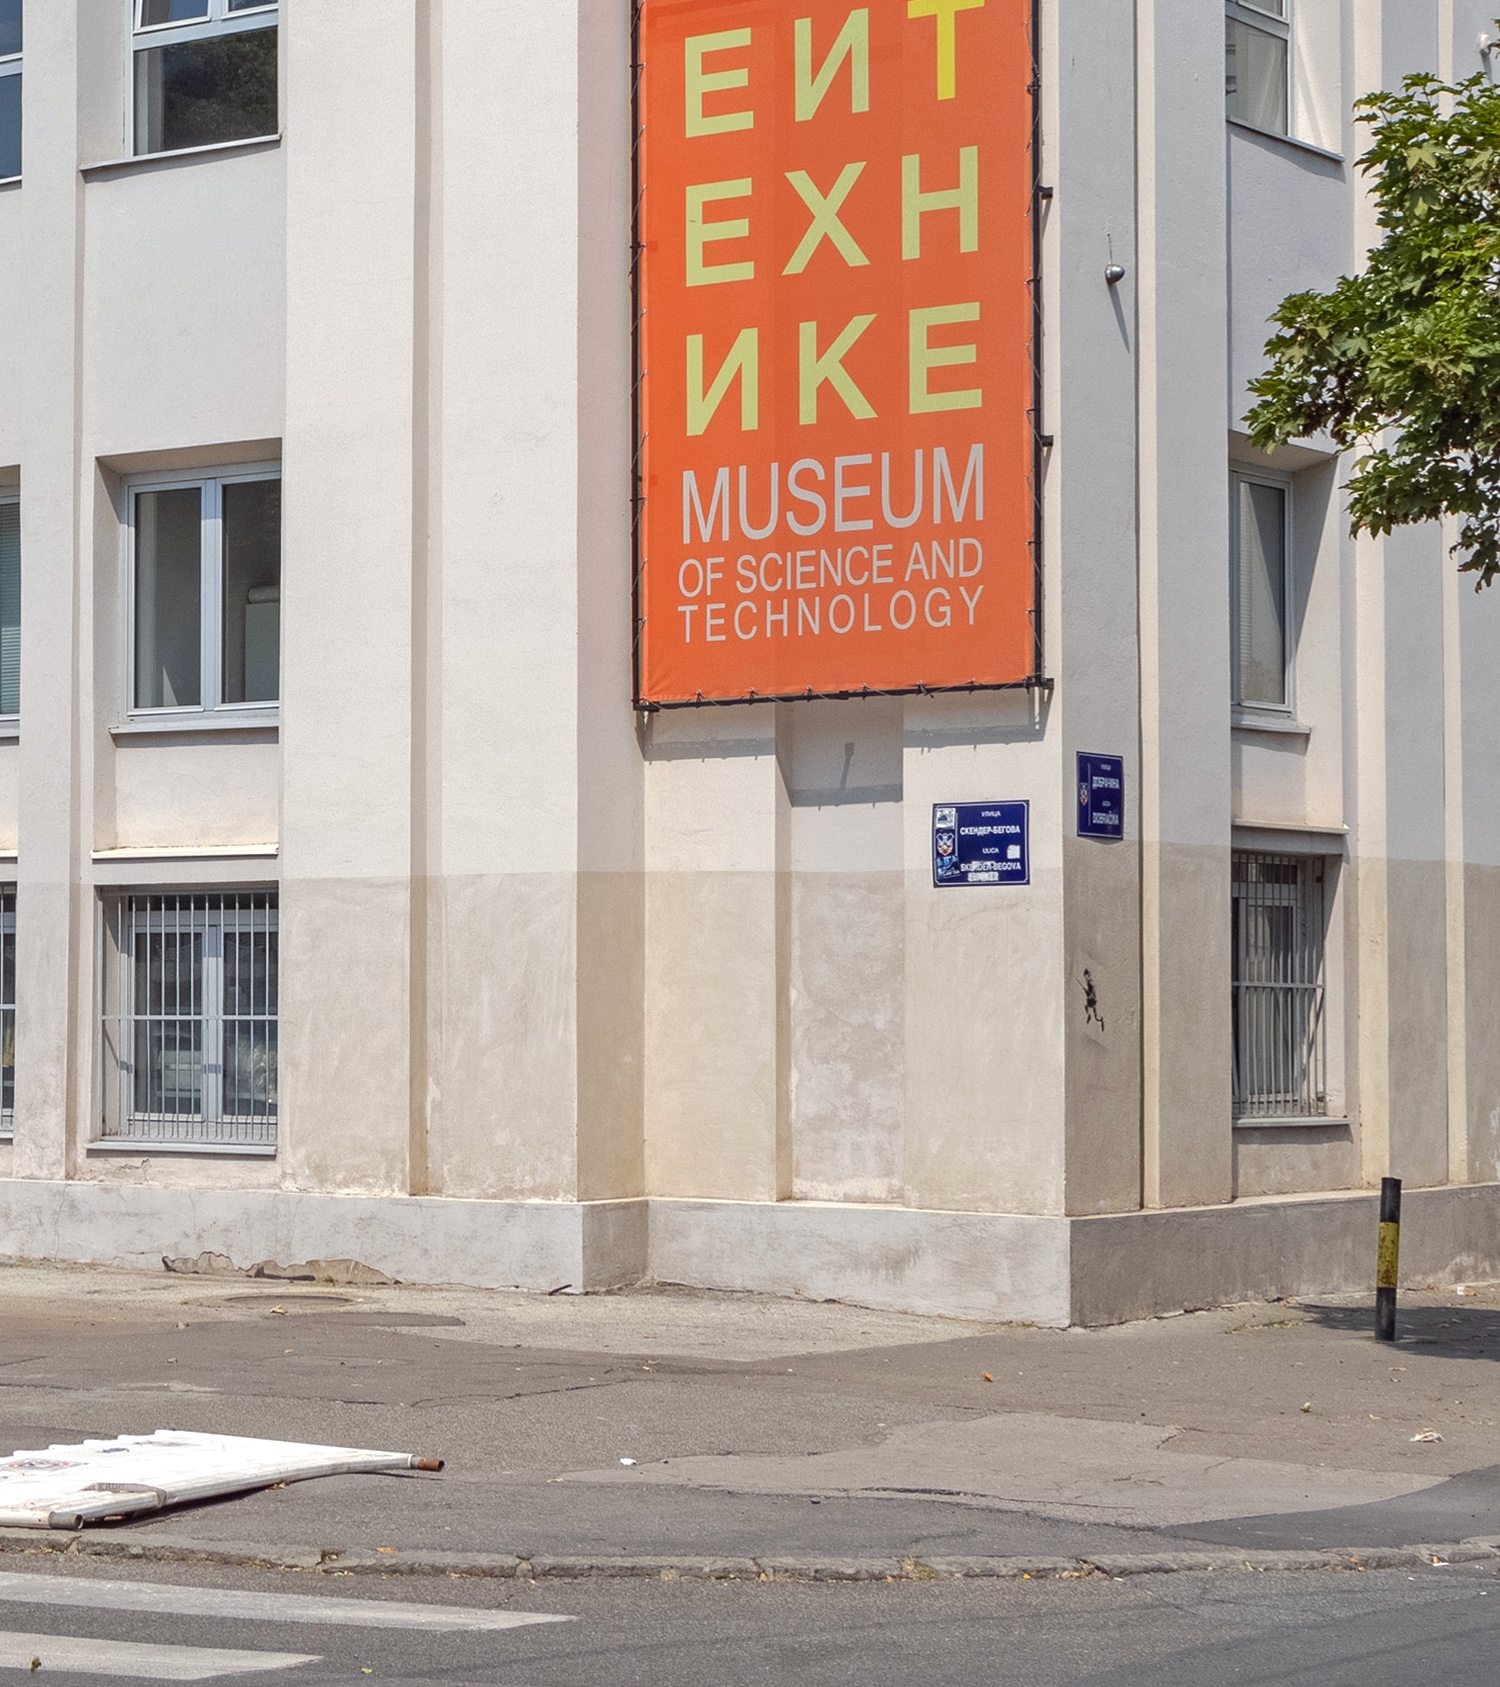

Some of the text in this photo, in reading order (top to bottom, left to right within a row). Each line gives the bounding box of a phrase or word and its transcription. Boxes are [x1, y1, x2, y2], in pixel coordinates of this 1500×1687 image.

[682, 442, 984, 545] MUSEUM
[677, 537, 984, 598] OF SCIENCE AND
[677, 584, 985, 644] TECHNOLOGY
[960, 825, 1021, 837] СКЕНДЕР-БЕГОВА
